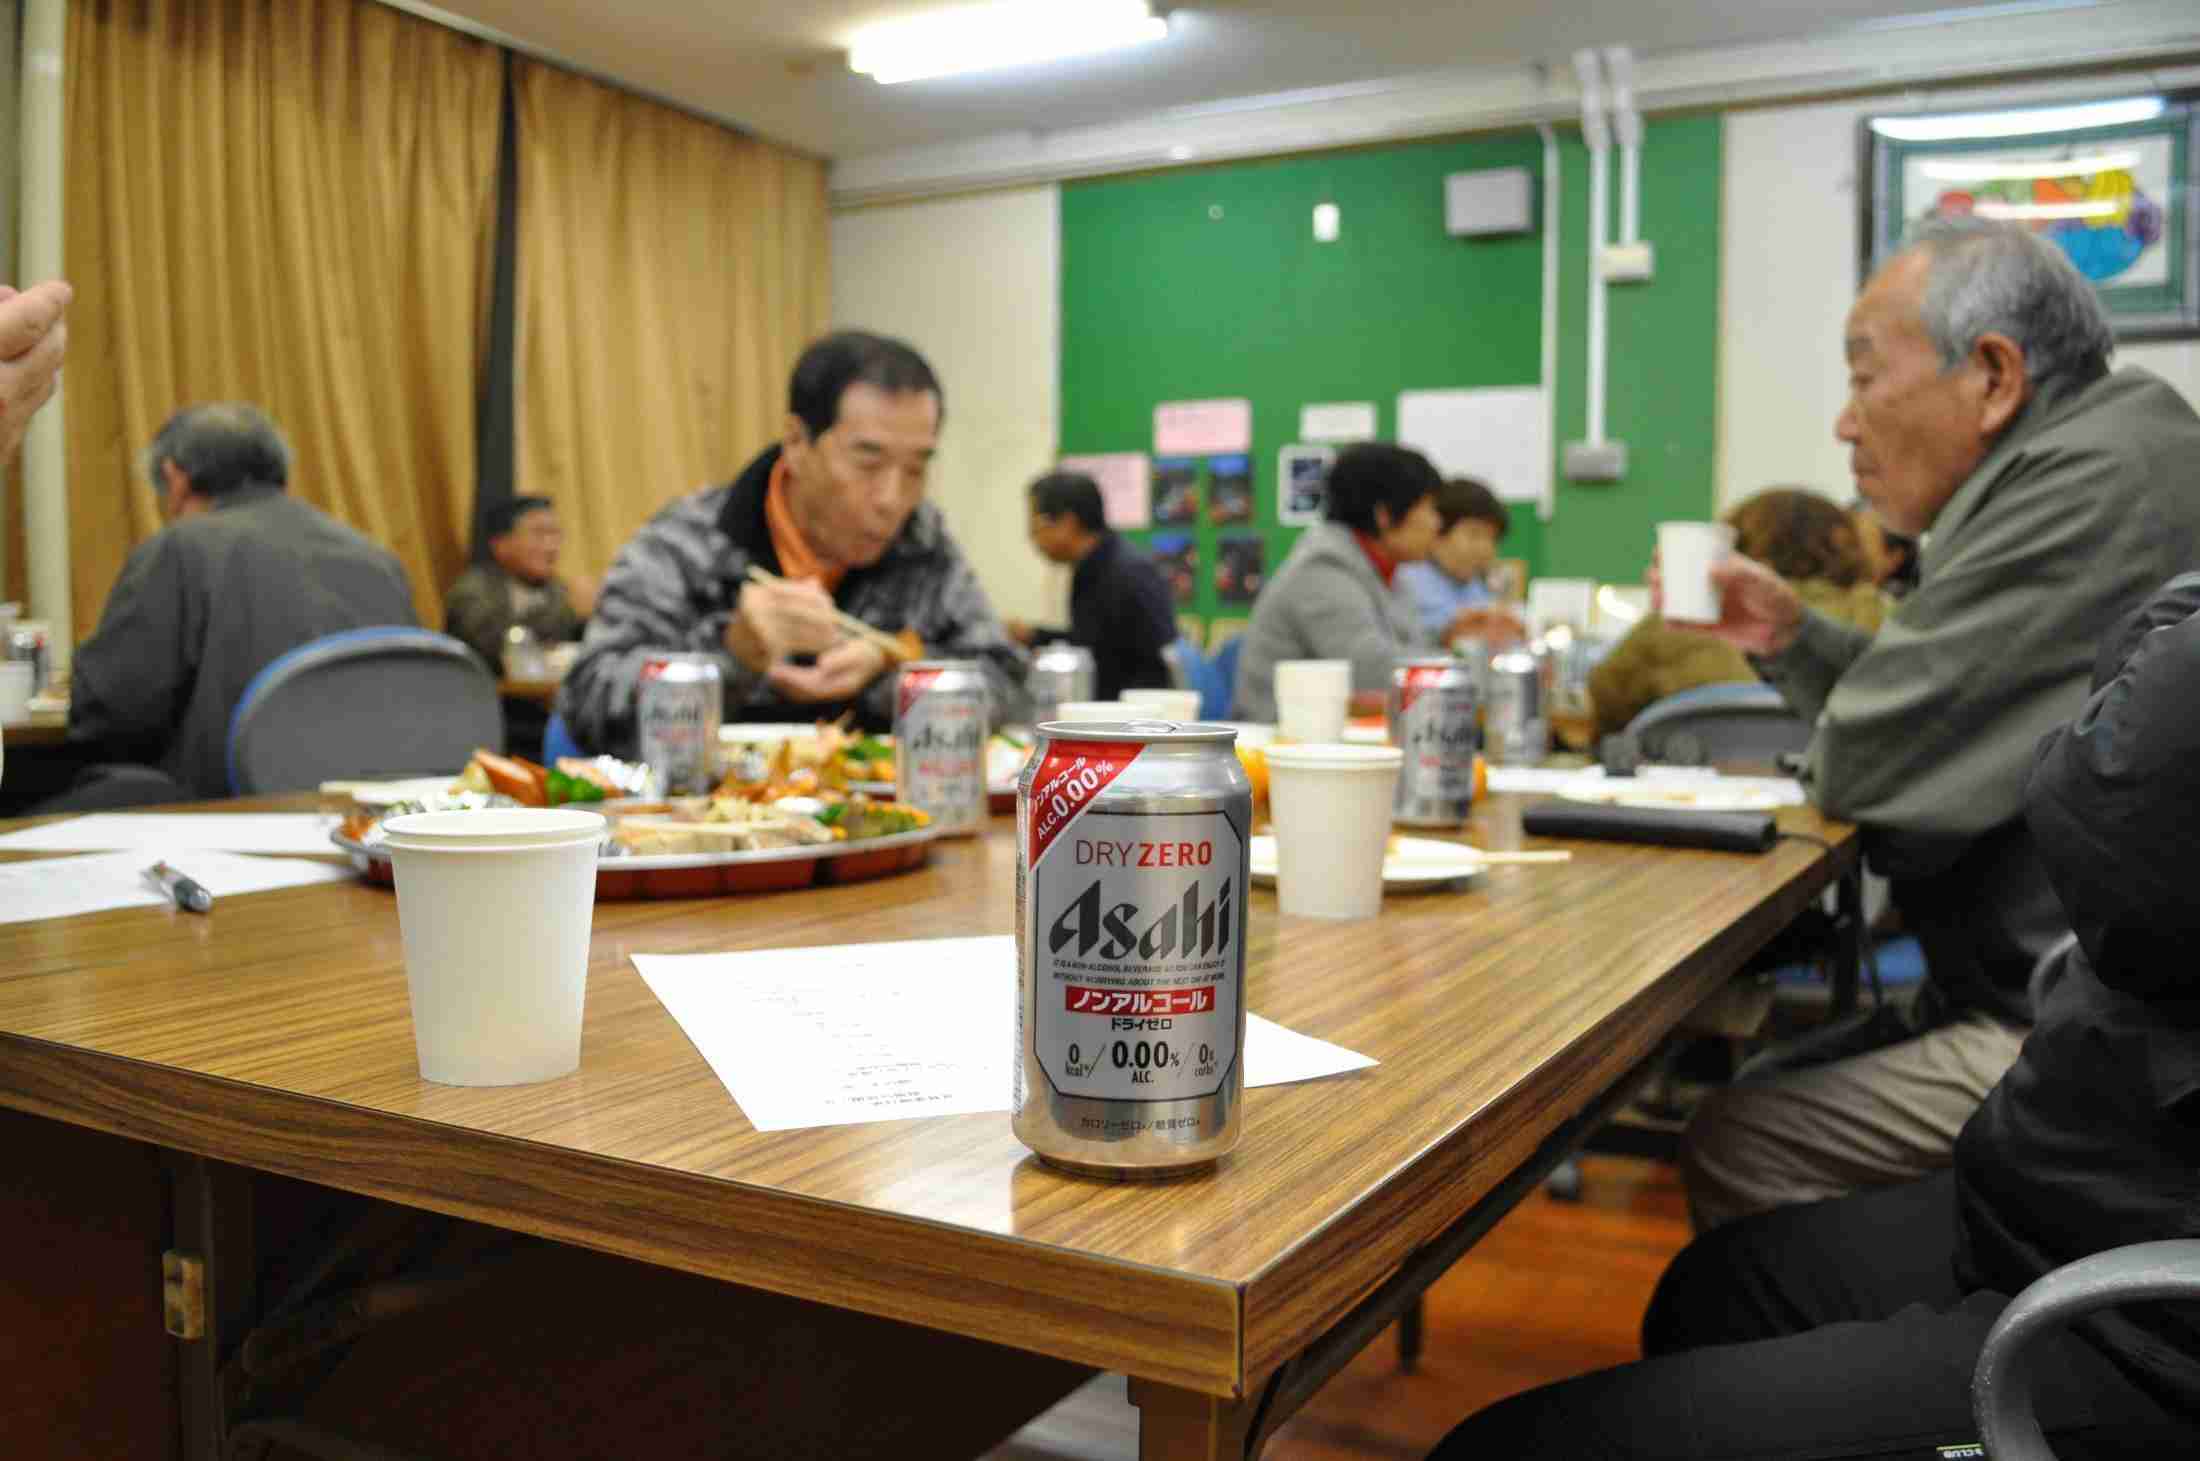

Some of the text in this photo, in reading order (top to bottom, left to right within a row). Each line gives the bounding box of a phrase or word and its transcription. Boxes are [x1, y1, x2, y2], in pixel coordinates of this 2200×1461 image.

[1049, 876, 1231, 960] Asahi
[1072, 990, 1208, 1013] ノンアルコール
[1111, 1017, 1172, 1031] ドライゼロ
[1068, 1043, 1080, 1065] 0
[1111, 1040, 1180, 1069] 0.00%
[1131, 1070, 1154, 1084] ALC.
